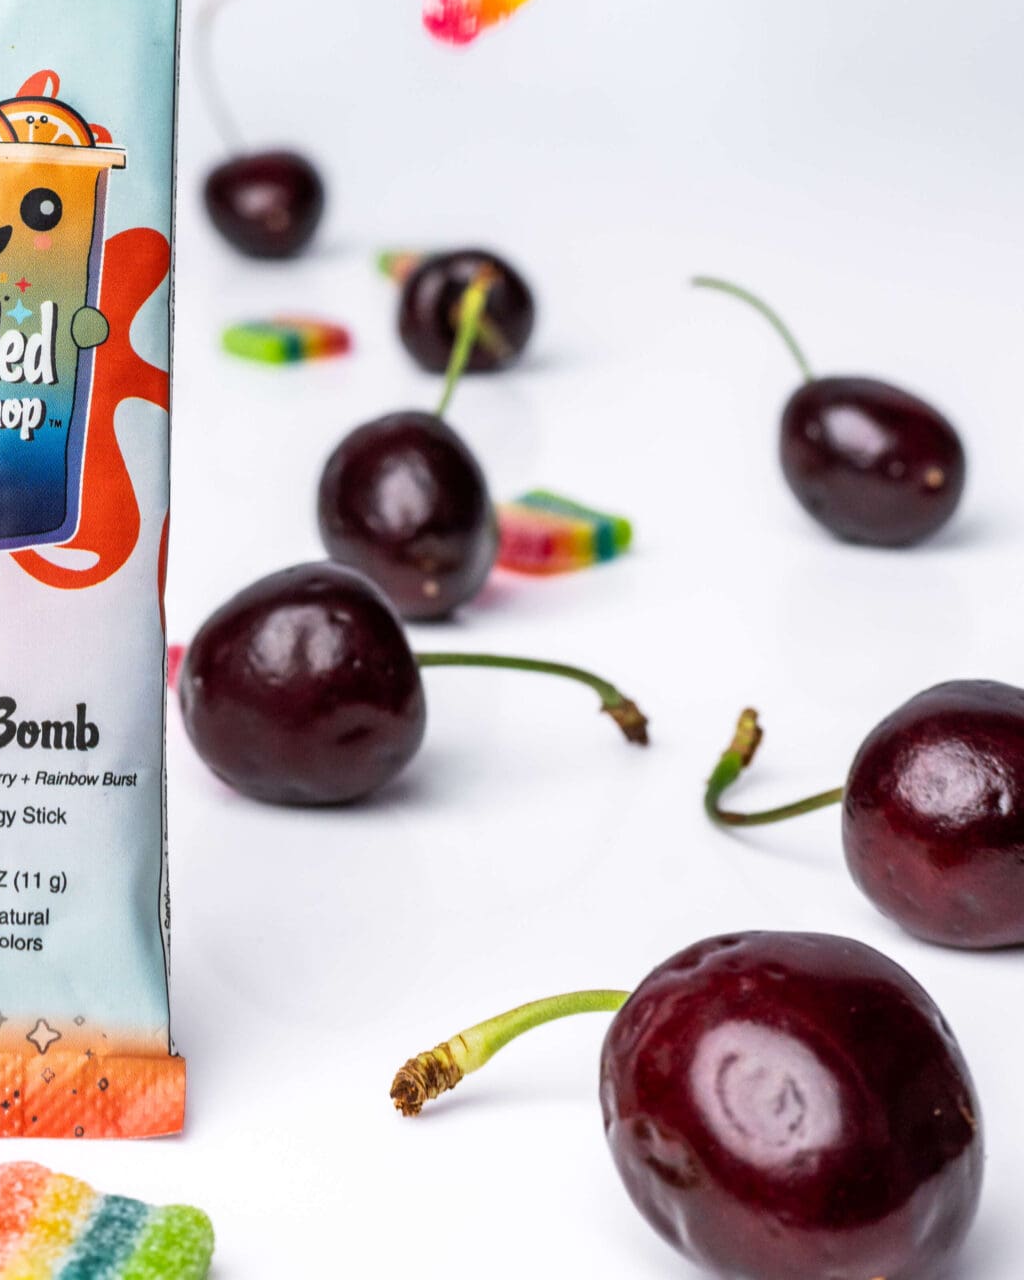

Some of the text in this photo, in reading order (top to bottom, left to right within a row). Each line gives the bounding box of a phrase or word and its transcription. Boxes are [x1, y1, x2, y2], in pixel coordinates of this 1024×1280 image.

[34, 770, 99, 787] Rainbow
[102, 771, 138, 787] Burst
[22, 806, 68, 825] Stick
[13, 870, 41, 893] (11
[49, 871, 68, 894] g)
